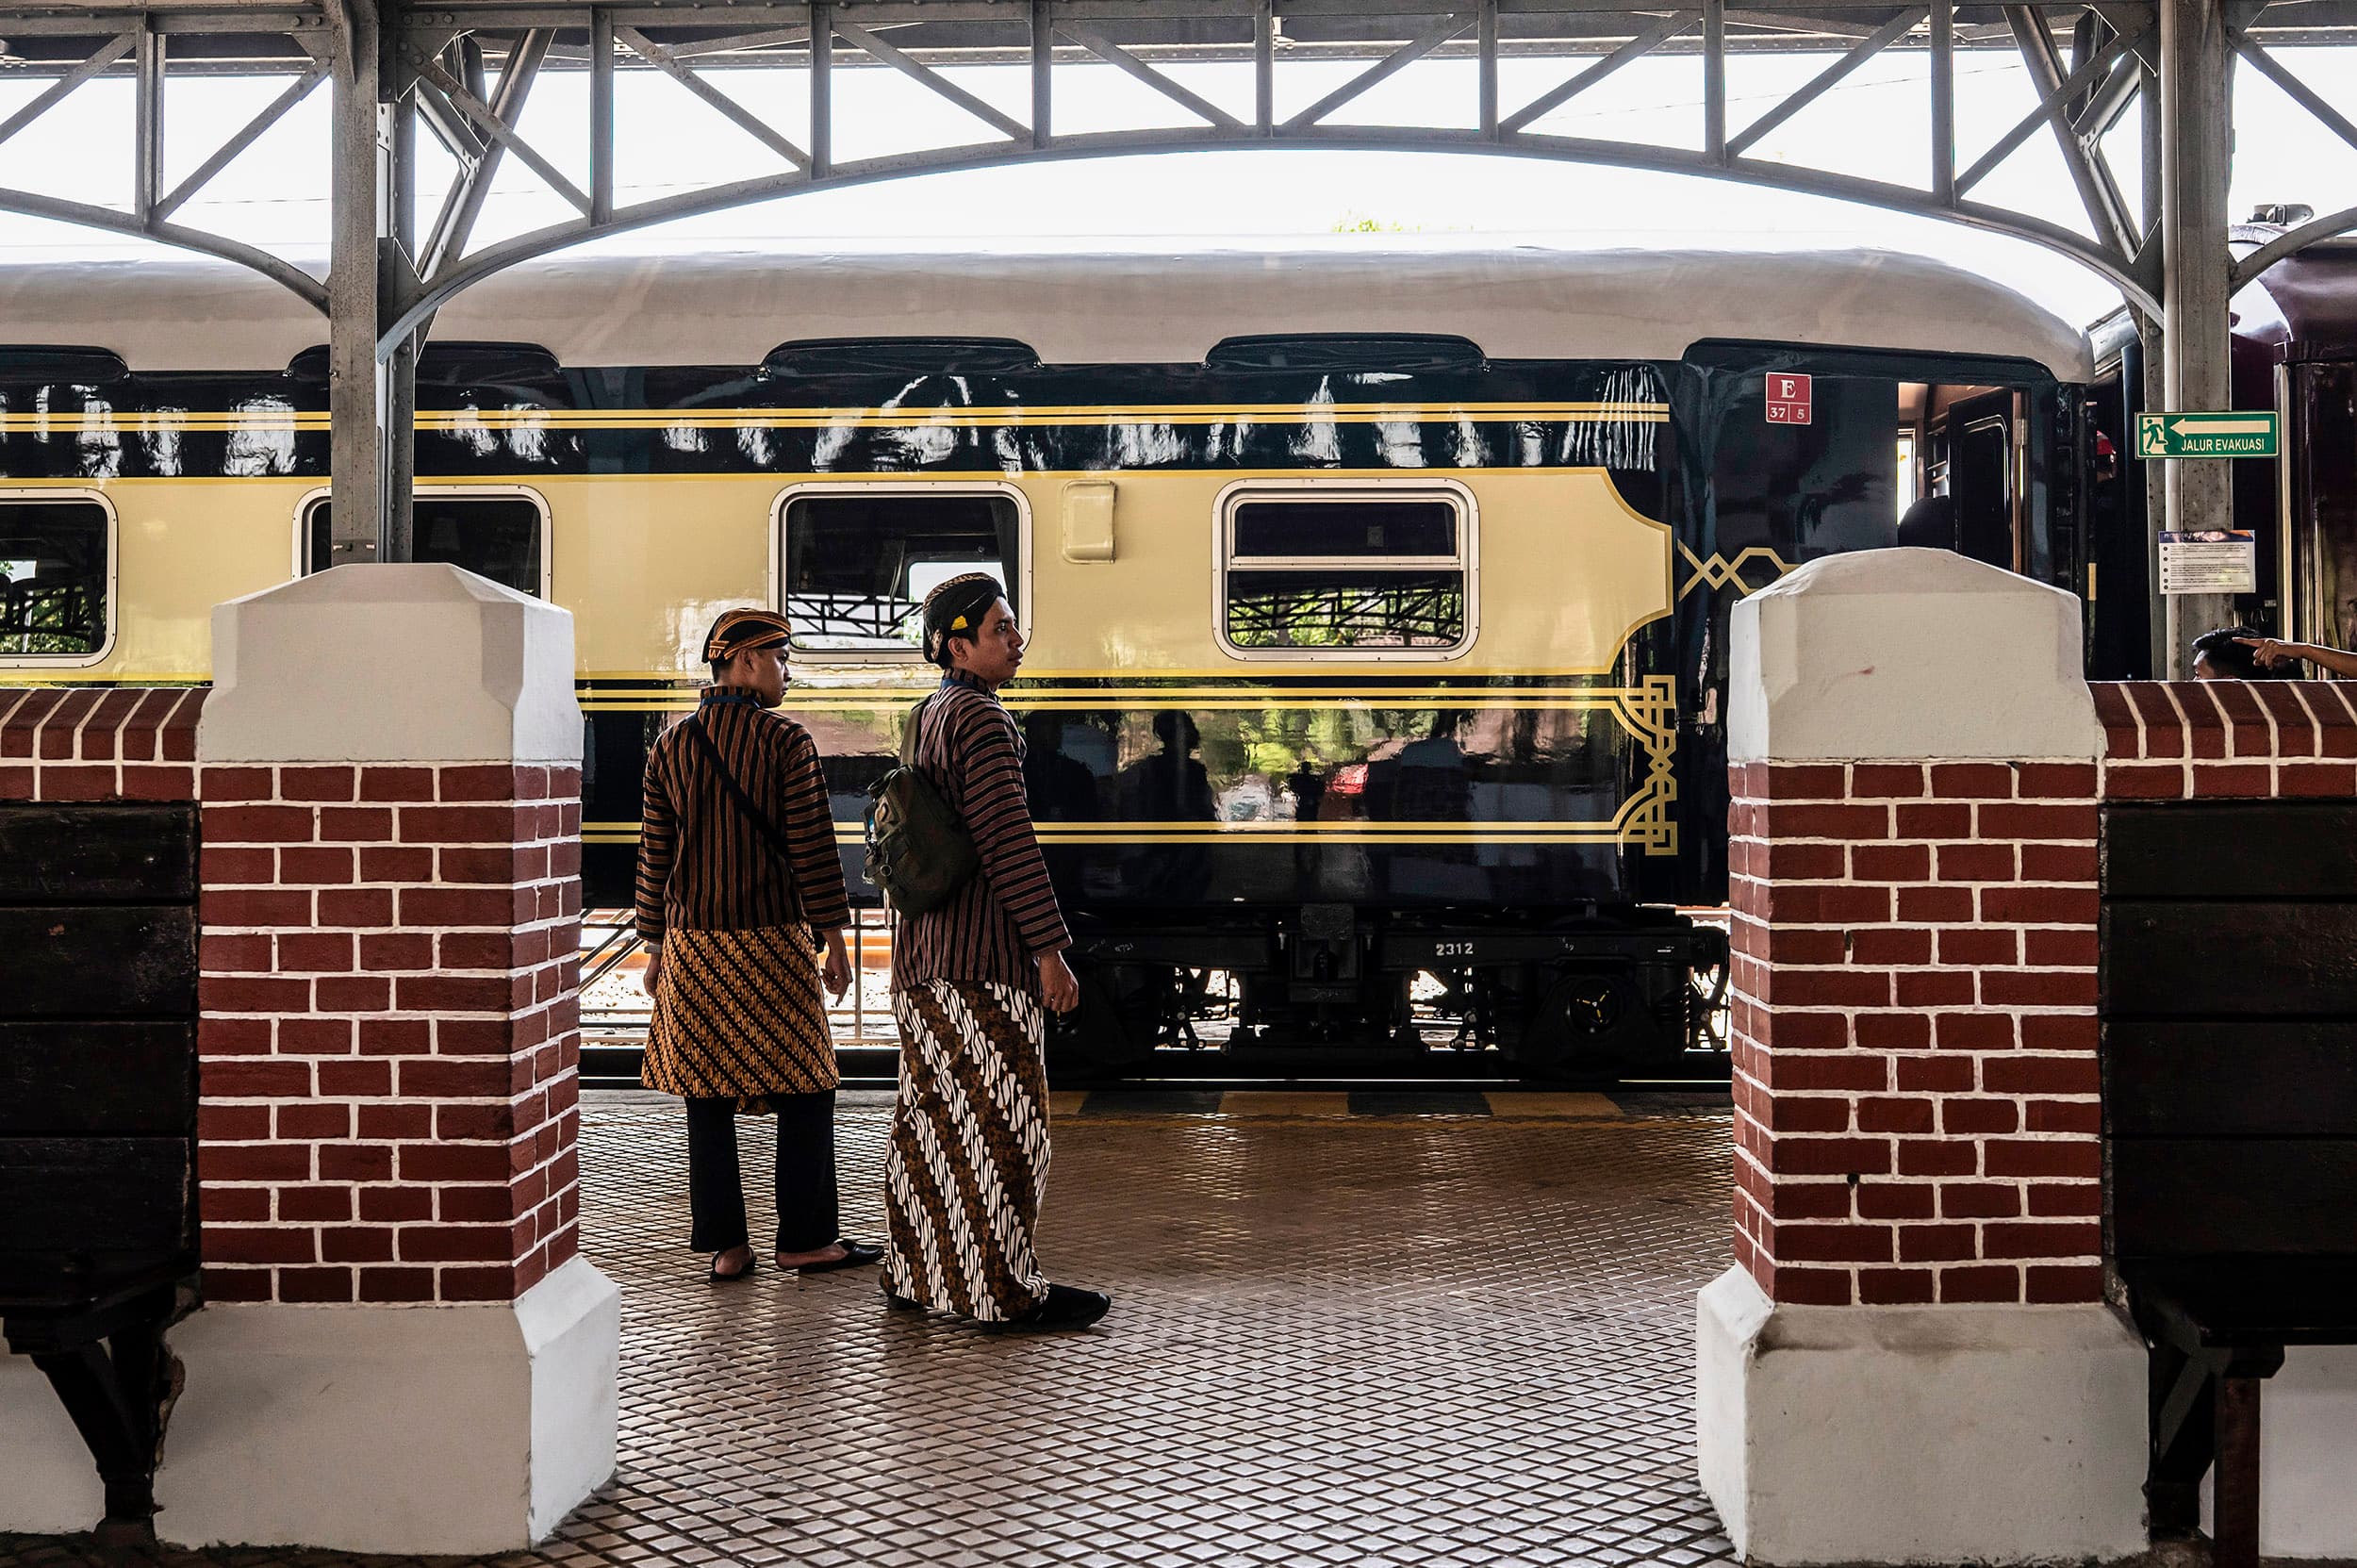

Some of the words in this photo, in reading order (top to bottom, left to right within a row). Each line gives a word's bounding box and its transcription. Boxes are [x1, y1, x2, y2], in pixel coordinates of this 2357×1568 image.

[1781, 379, 1796, 398] E
[1770, 407, 1786, 419] 37
[2181, 439, 2213, 452] JALUR
[2216, 438, 2265, 452] EVAKUASI
[1436, 943, 1474, 956] 2312
